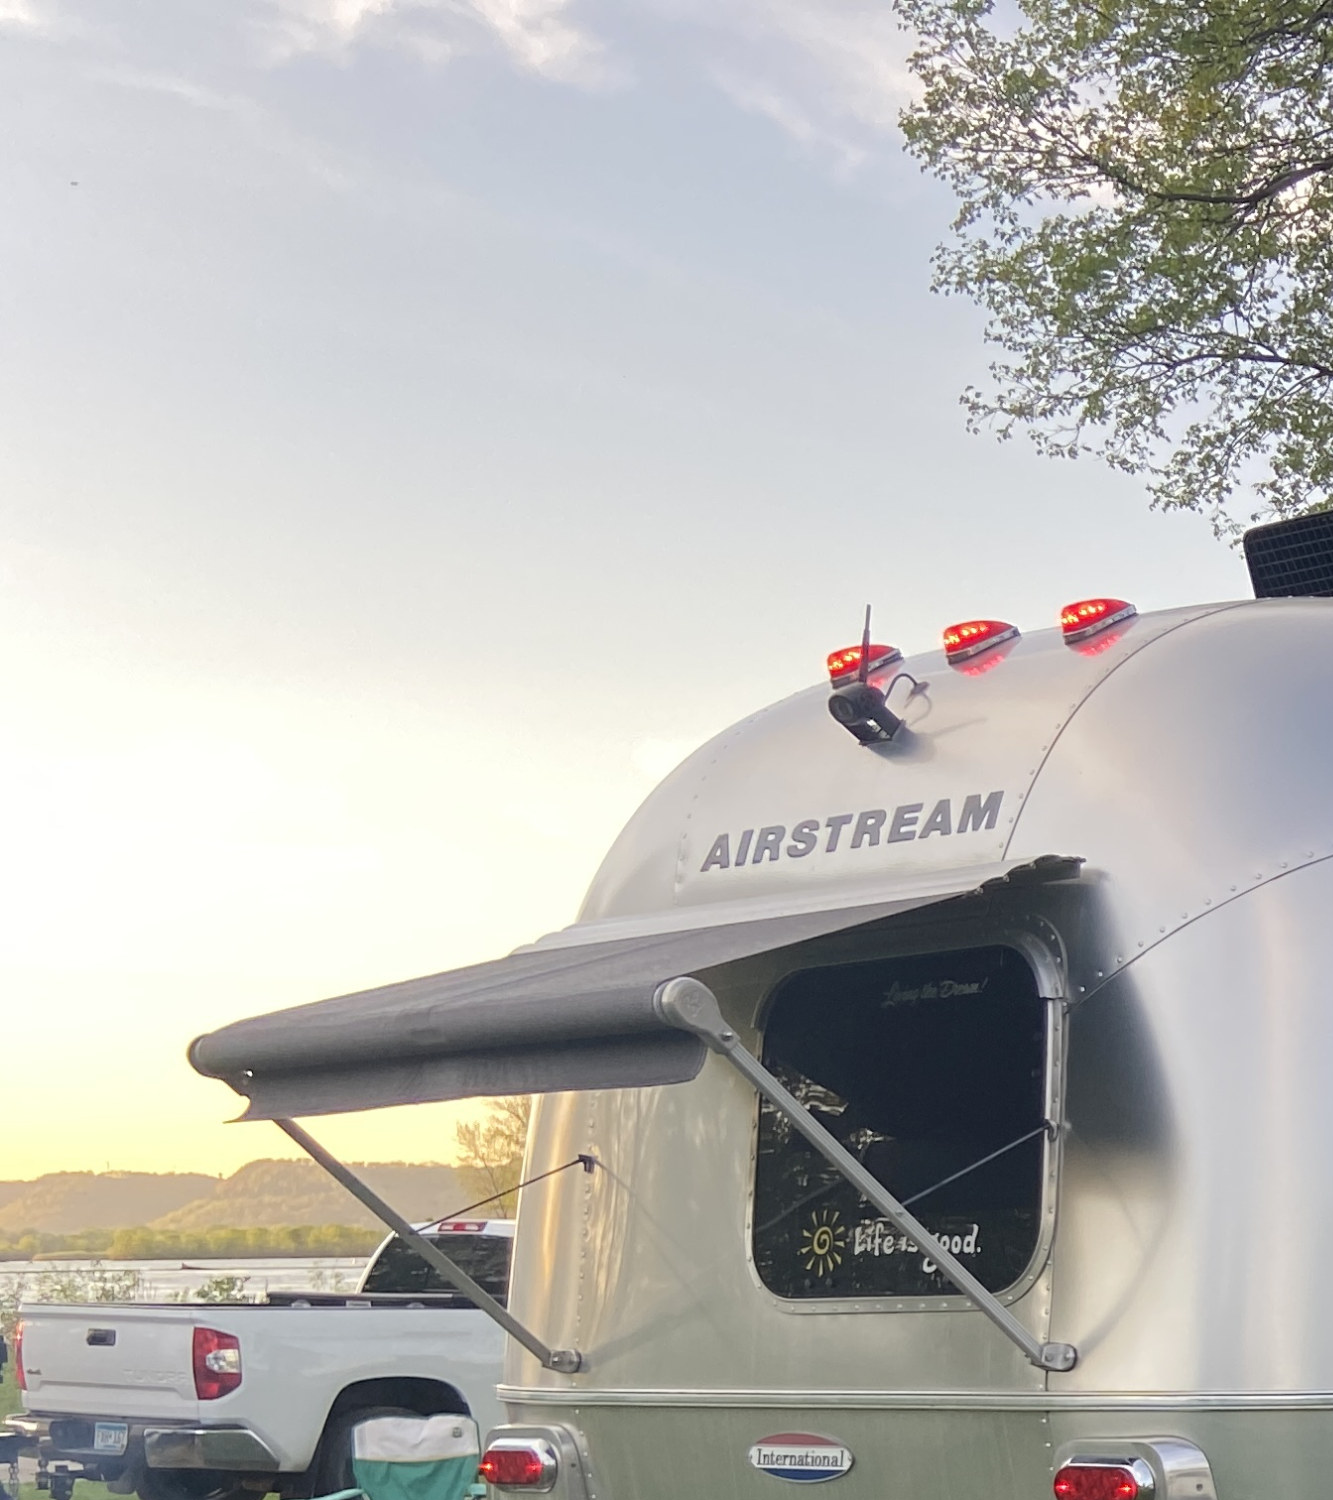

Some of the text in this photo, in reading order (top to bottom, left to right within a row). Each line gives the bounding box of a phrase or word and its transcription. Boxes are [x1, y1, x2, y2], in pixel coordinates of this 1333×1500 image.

[700, 790, 1005, 873] AIRSTREAM
[854, 1222, 895, 1256] Life
[756, 1447, 844, 1468] International
